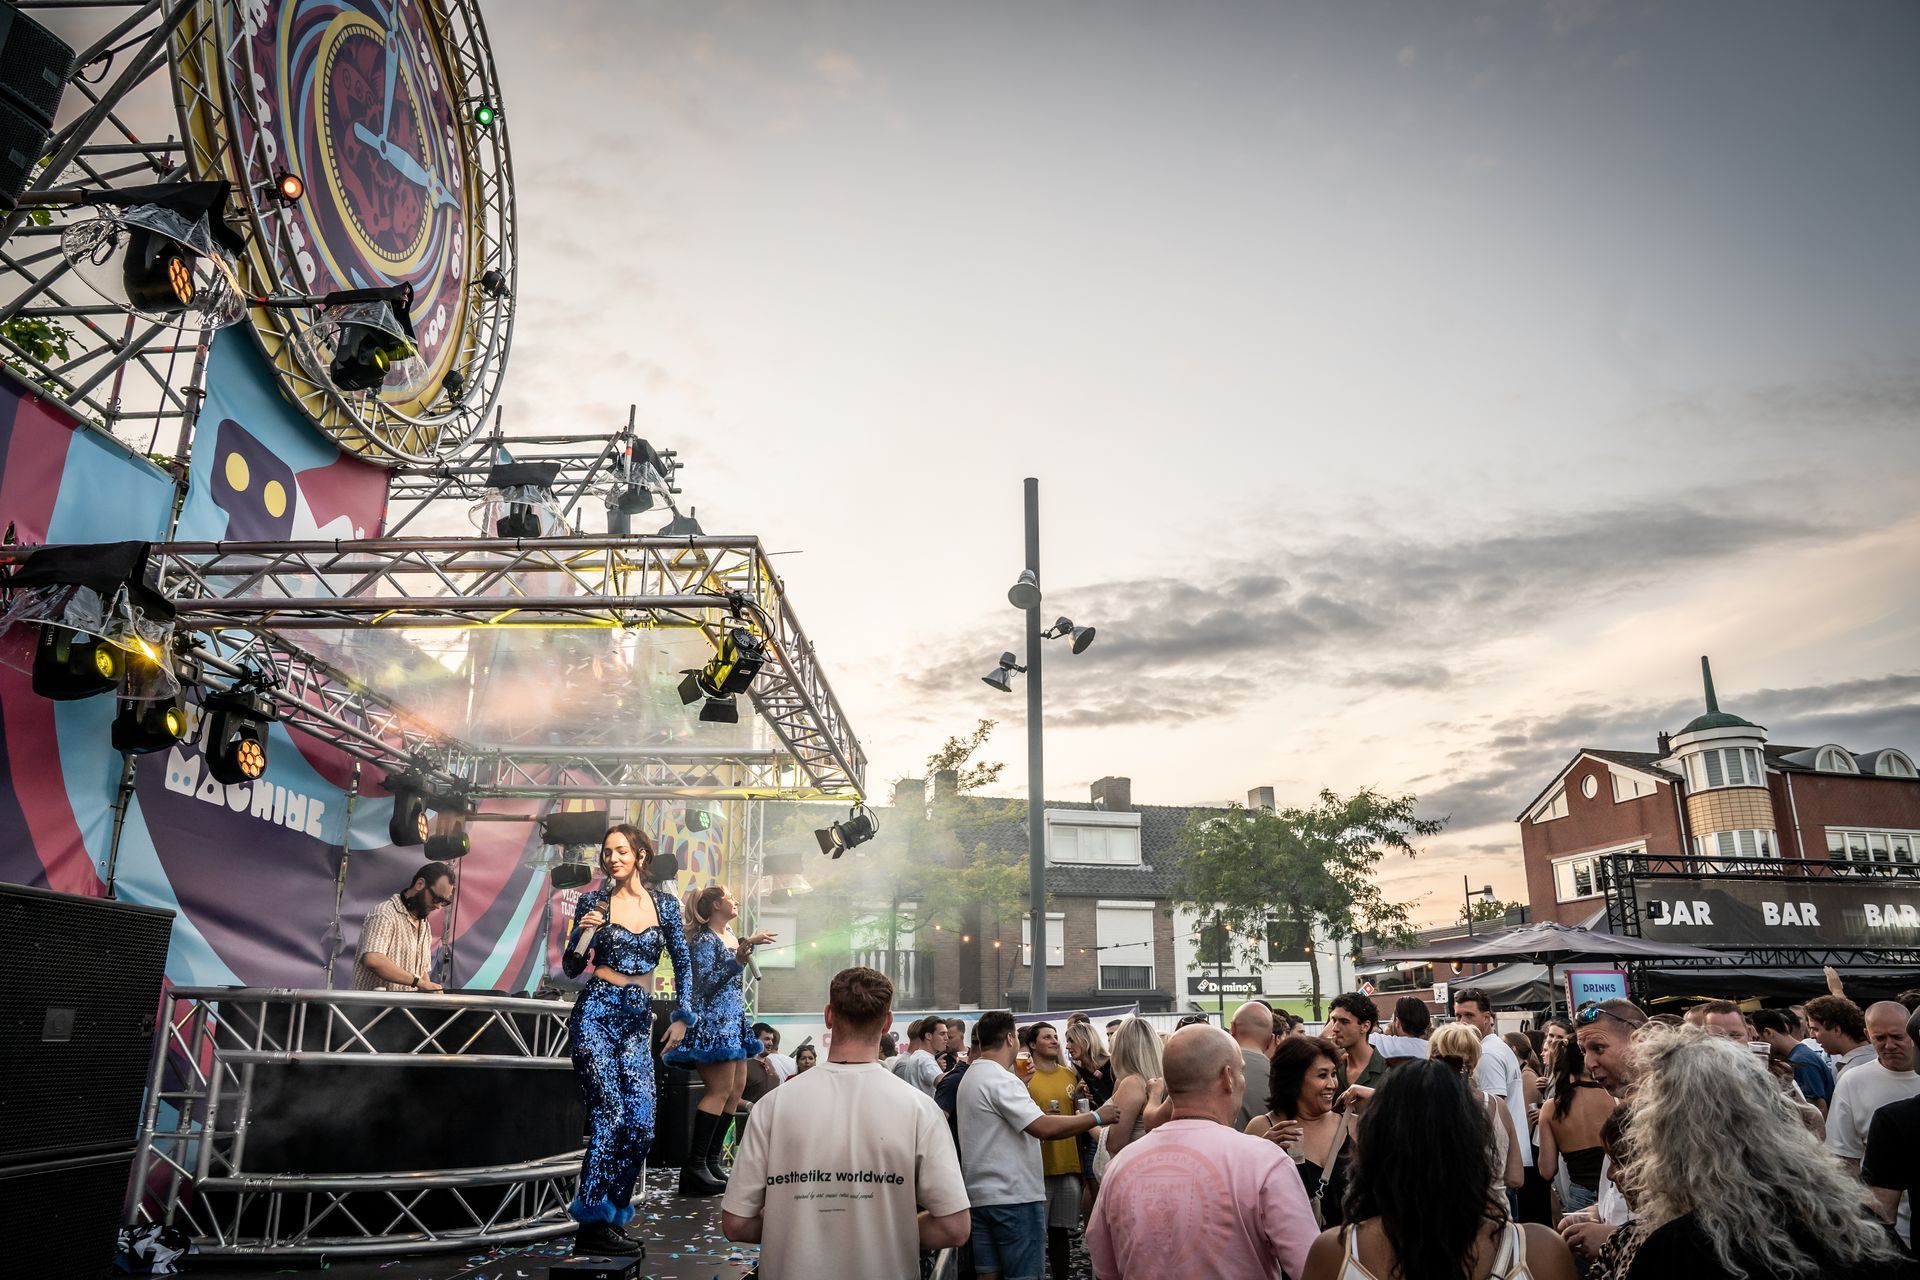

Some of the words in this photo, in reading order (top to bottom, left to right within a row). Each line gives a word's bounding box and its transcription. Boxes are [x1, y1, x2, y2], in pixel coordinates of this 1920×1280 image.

[164, 745, 325, 838] MACHINE
[1652, 900, 1714, 926] BAR
[1762, 901, 1820, 926] BAR
[1863, 903, 1920, 928] BAR
[1583, 983, 1616, 993] DRINKS
[767, 1169, 832, 1185] aesthetikz
[836, 1170, 904, 1185] worldwide
[1141, 1183, 1187, 1194] MIAMI
